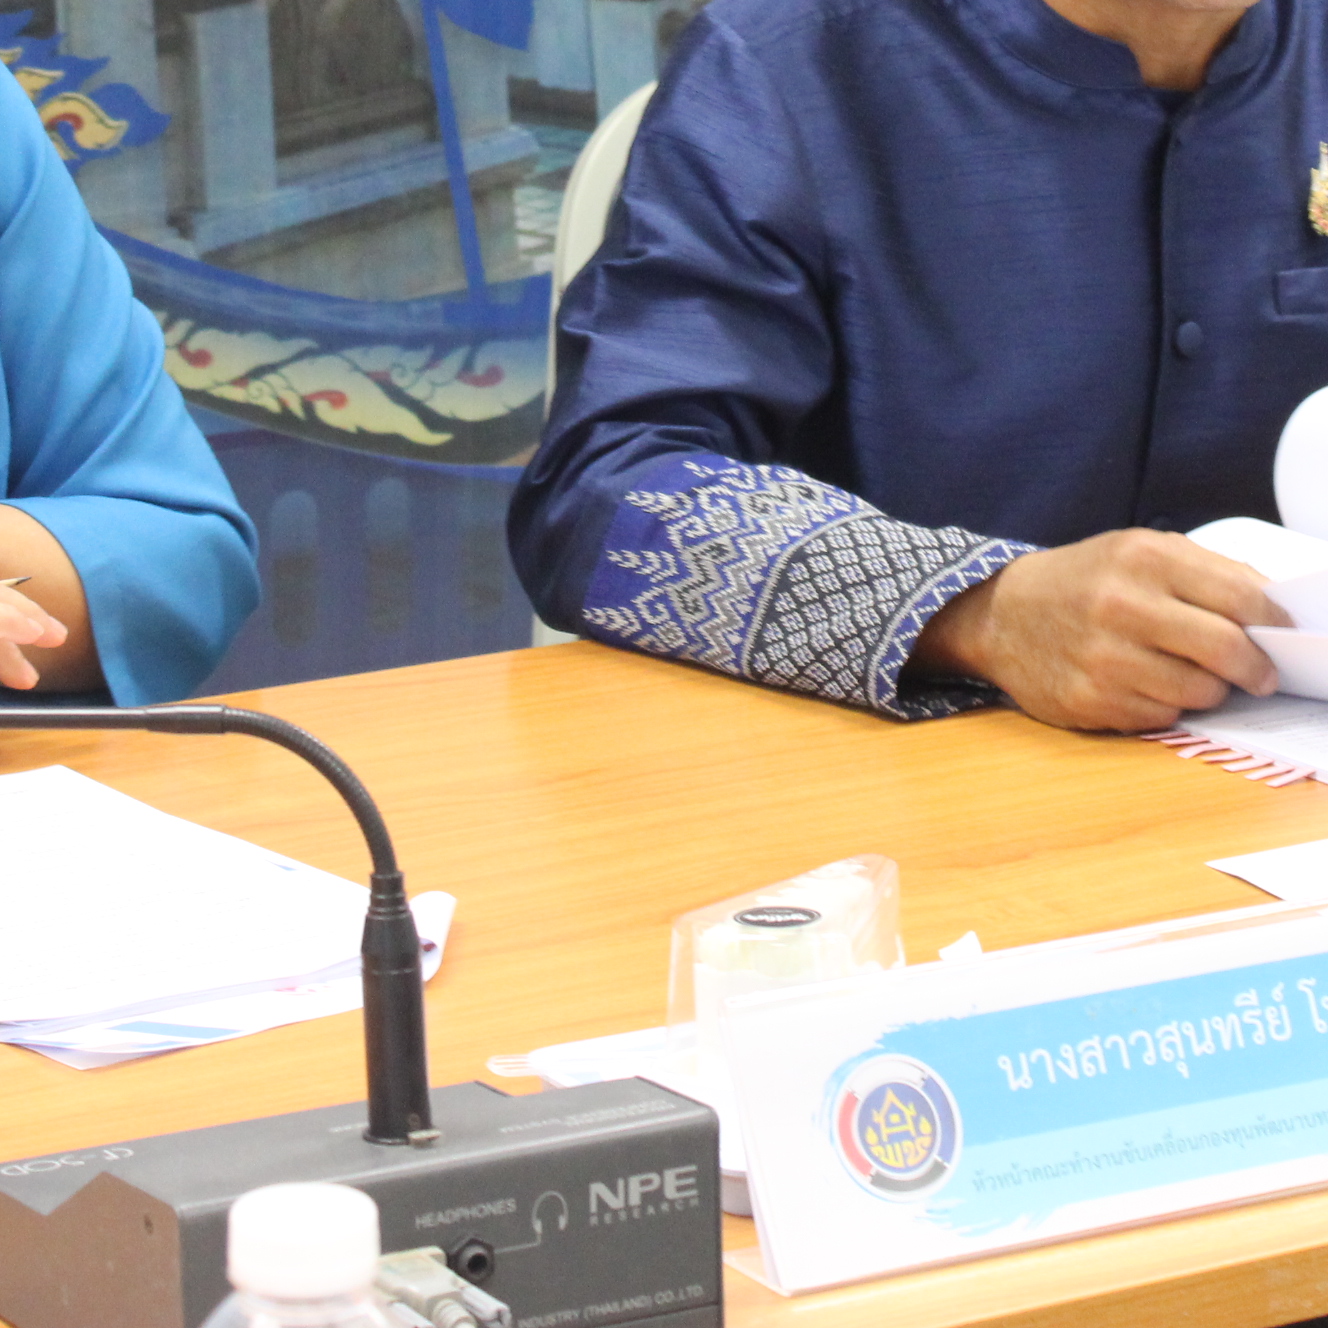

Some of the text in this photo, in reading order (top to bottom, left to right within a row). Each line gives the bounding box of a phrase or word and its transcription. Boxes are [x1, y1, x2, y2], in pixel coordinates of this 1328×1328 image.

[996, 981, 1293, 1092] นางสาวสุนทรีย์
[587, 1163, 700, 1214] NPE
[414, 1197, 518, 1230] HEADPHONES
[587, 1196, 700, 1228] RESEARCH
